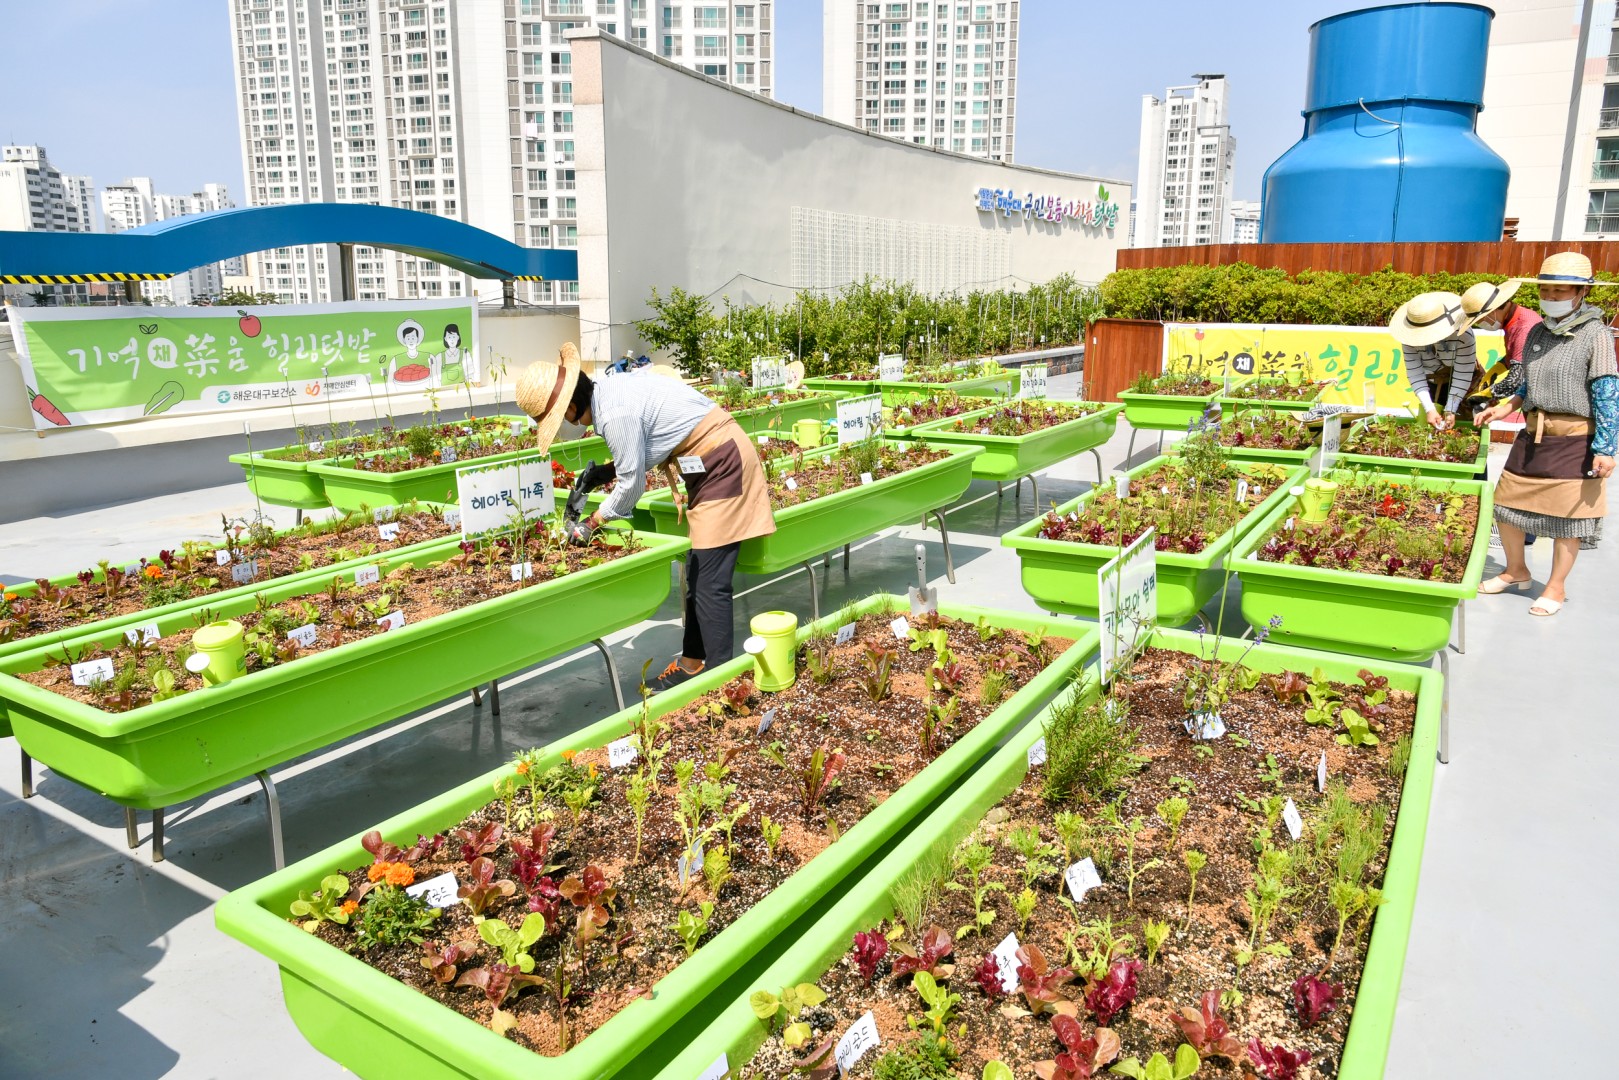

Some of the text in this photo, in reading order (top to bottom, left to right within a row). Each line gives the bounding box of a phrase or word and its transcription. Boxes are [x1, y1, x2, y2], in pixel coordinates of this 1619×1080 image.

[995, 189, 1022, 216] 해운대
[261, 327, 377, 374] 힐링텃밭
[233, 387, 297, 401] 해운대구보건소
[323, 379, 357, 390] 치매안심센터
[843, 416, 864, 429] 헤아림
[471, 481, 545, 510] 헤아림 가족
[1142, 572, 1156, 604] 쉼터
[78, 665, 107, 683] 부추
